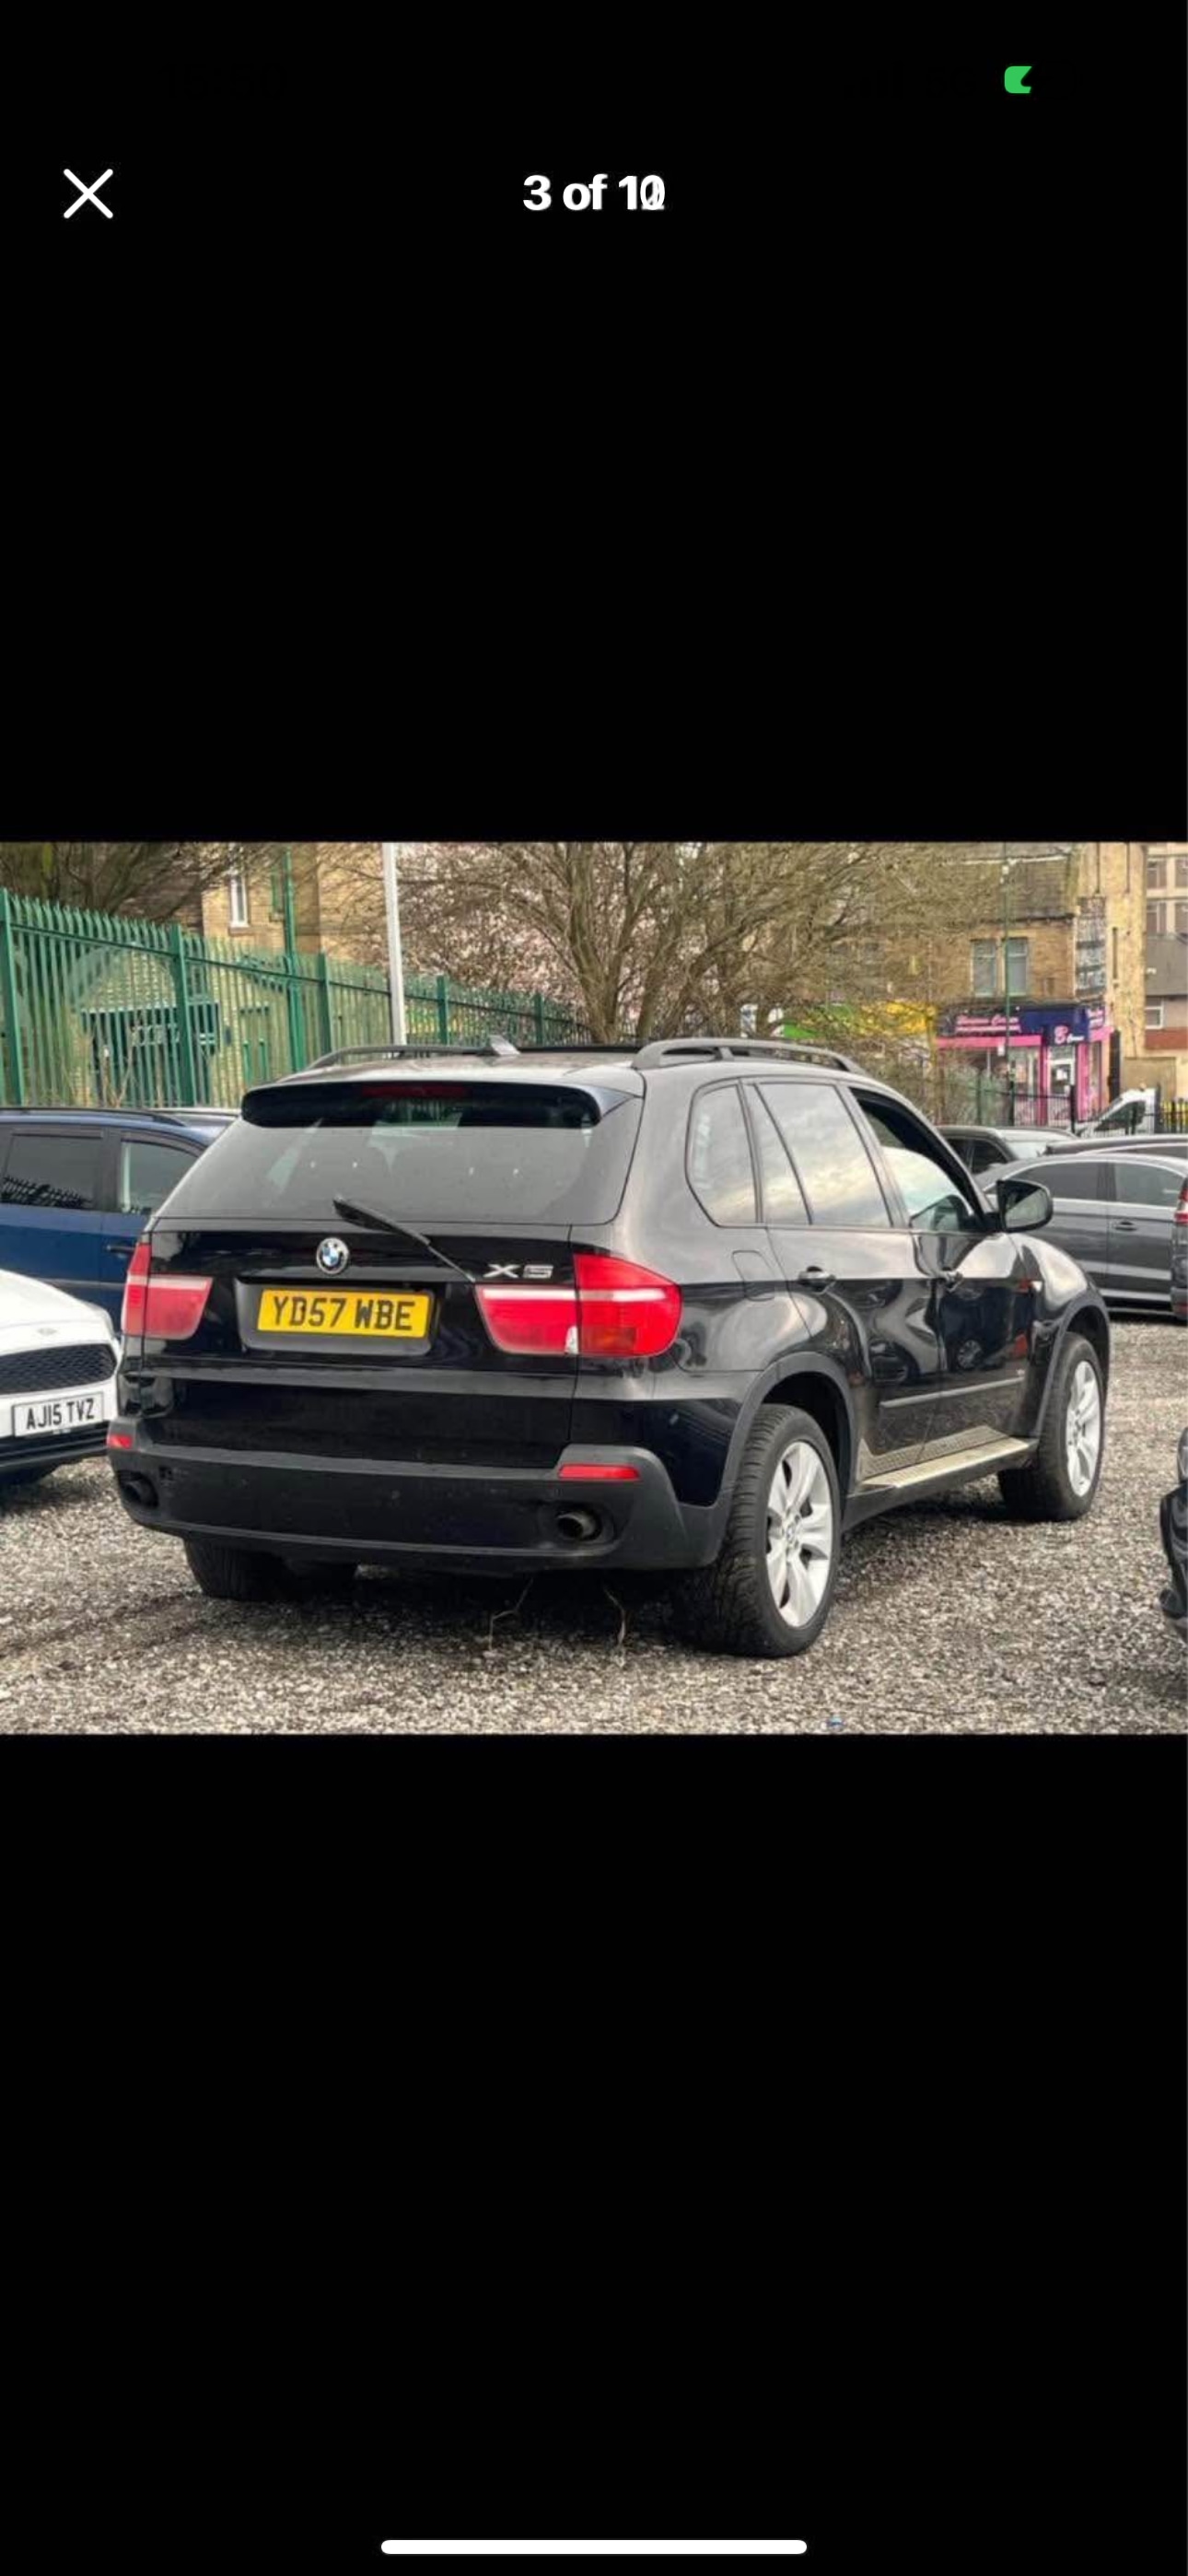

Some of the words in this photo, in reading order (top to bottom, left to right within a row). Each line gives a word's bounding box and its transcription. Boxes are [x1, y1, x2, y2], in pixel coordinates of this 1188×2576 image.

[483, 1263, 554, 1279] X5
[274, 1295, 348, 1329] YD57
[354, 1298, 416, 1331] WBE
[26, 1403, 63, 1430] AJ15
[66, 1398, 95, 1423] TVZ
